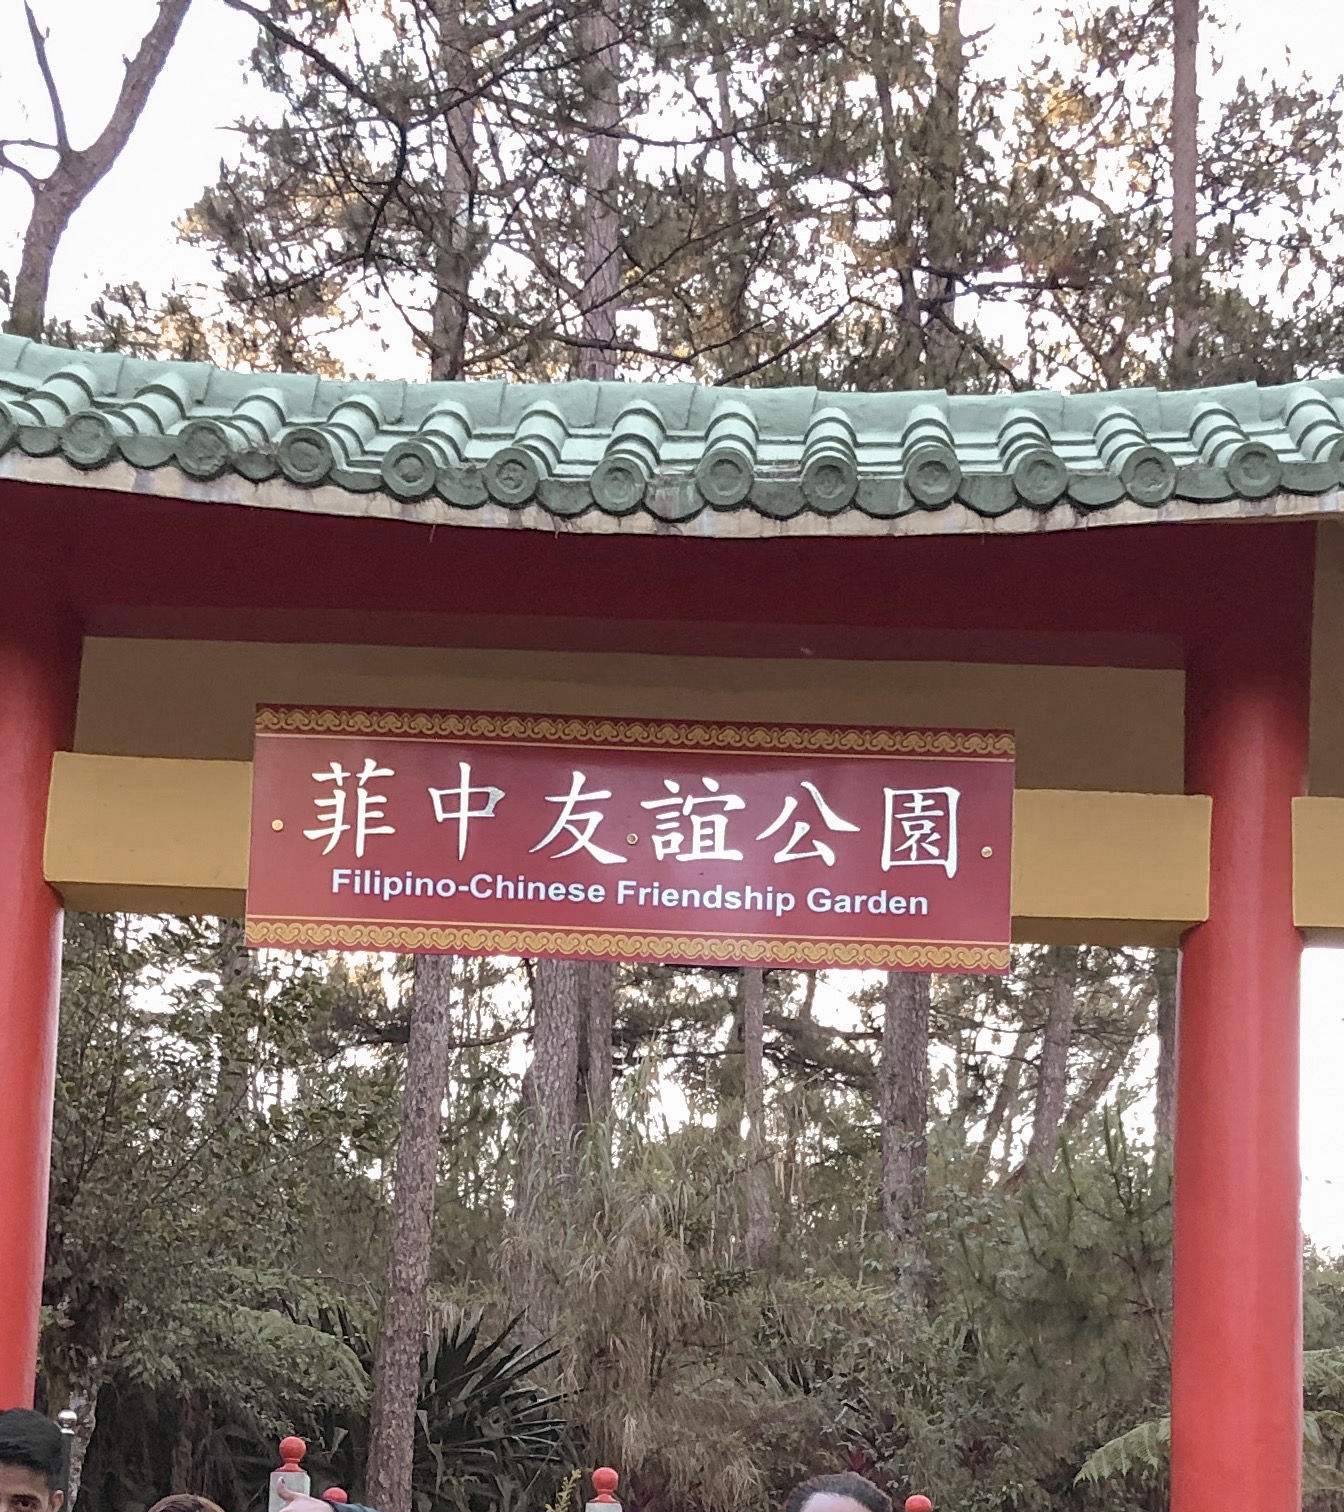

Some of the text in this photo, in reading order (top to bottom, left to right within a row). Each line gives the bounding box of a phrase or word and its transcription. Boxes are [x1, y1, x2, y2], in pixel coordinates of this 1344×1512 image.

[303, 758, 960, 879] 菲中友誼公園
[331, 868, 928, 916] Filipino-Chinese Friendship Garden
